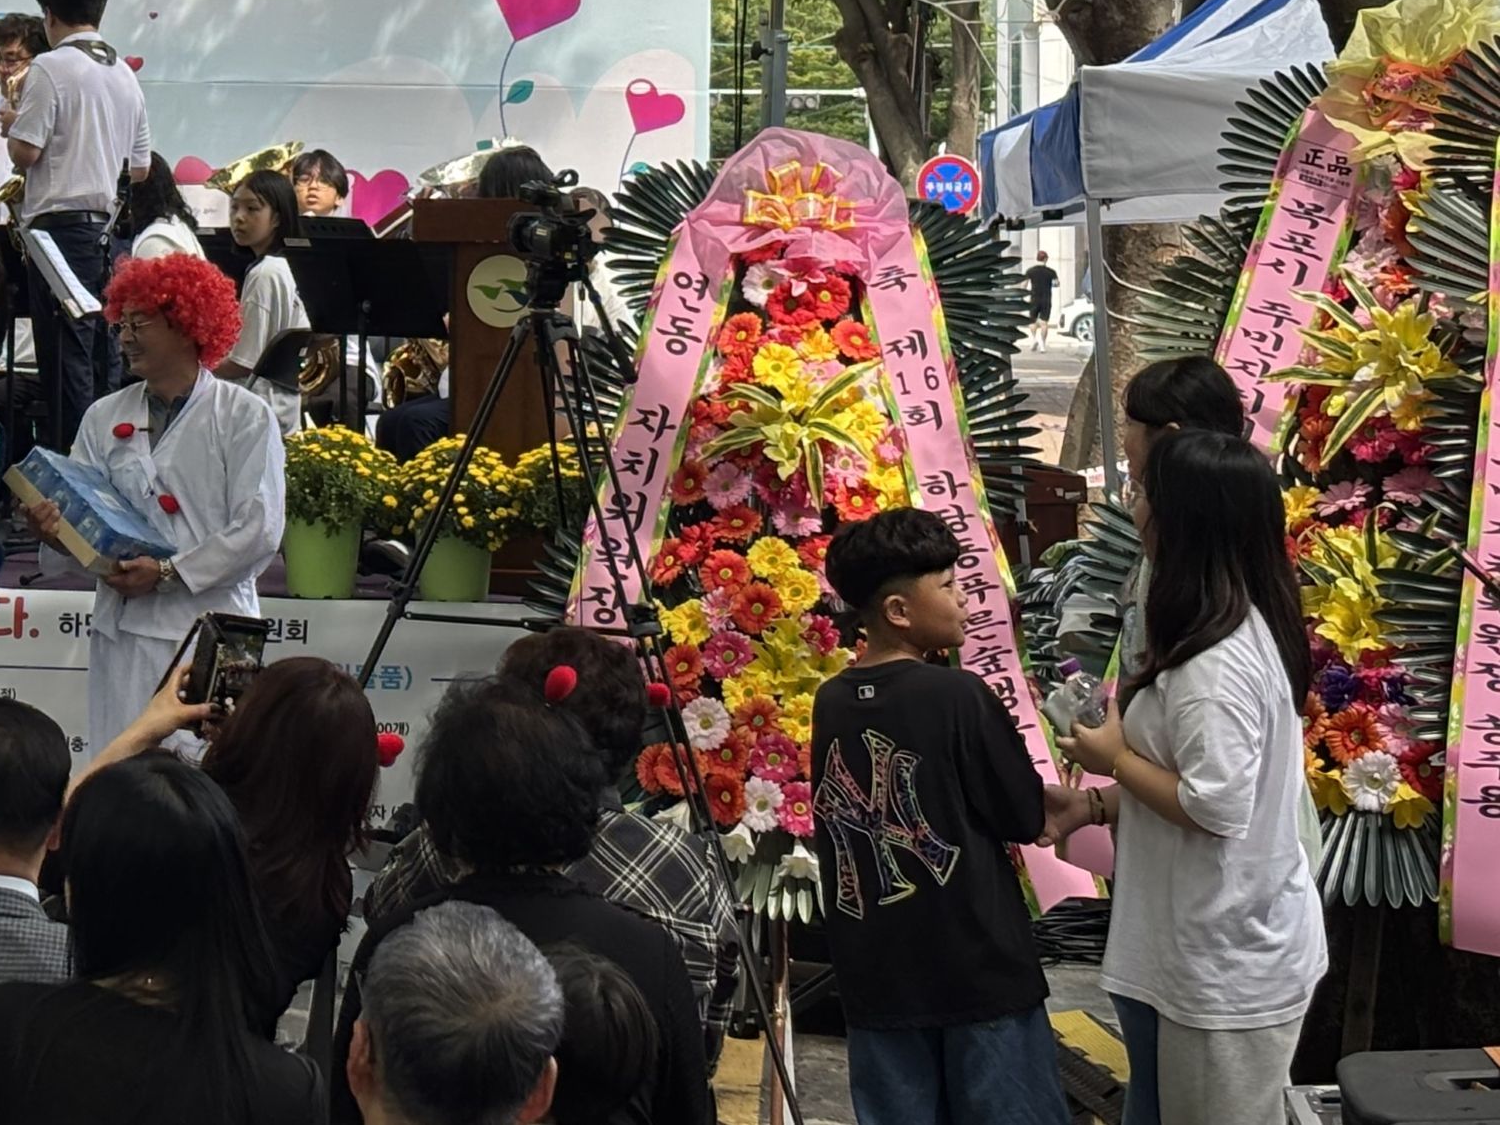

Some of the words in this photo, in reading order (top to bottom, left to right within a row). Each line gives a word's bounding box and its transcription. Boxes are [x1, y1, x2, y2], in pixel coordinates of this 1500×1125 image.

[1299, 148, 1352, 177] 正品
[871, 265, 918, 293] 축
[1259, 197, 1336, 287] 목포시
[655, 271, 708, 356] 연동
[885, 328, 943, 431] 제16회
[265, 618, 308, 645] 원회
[813, 729, 961, 920] NY
